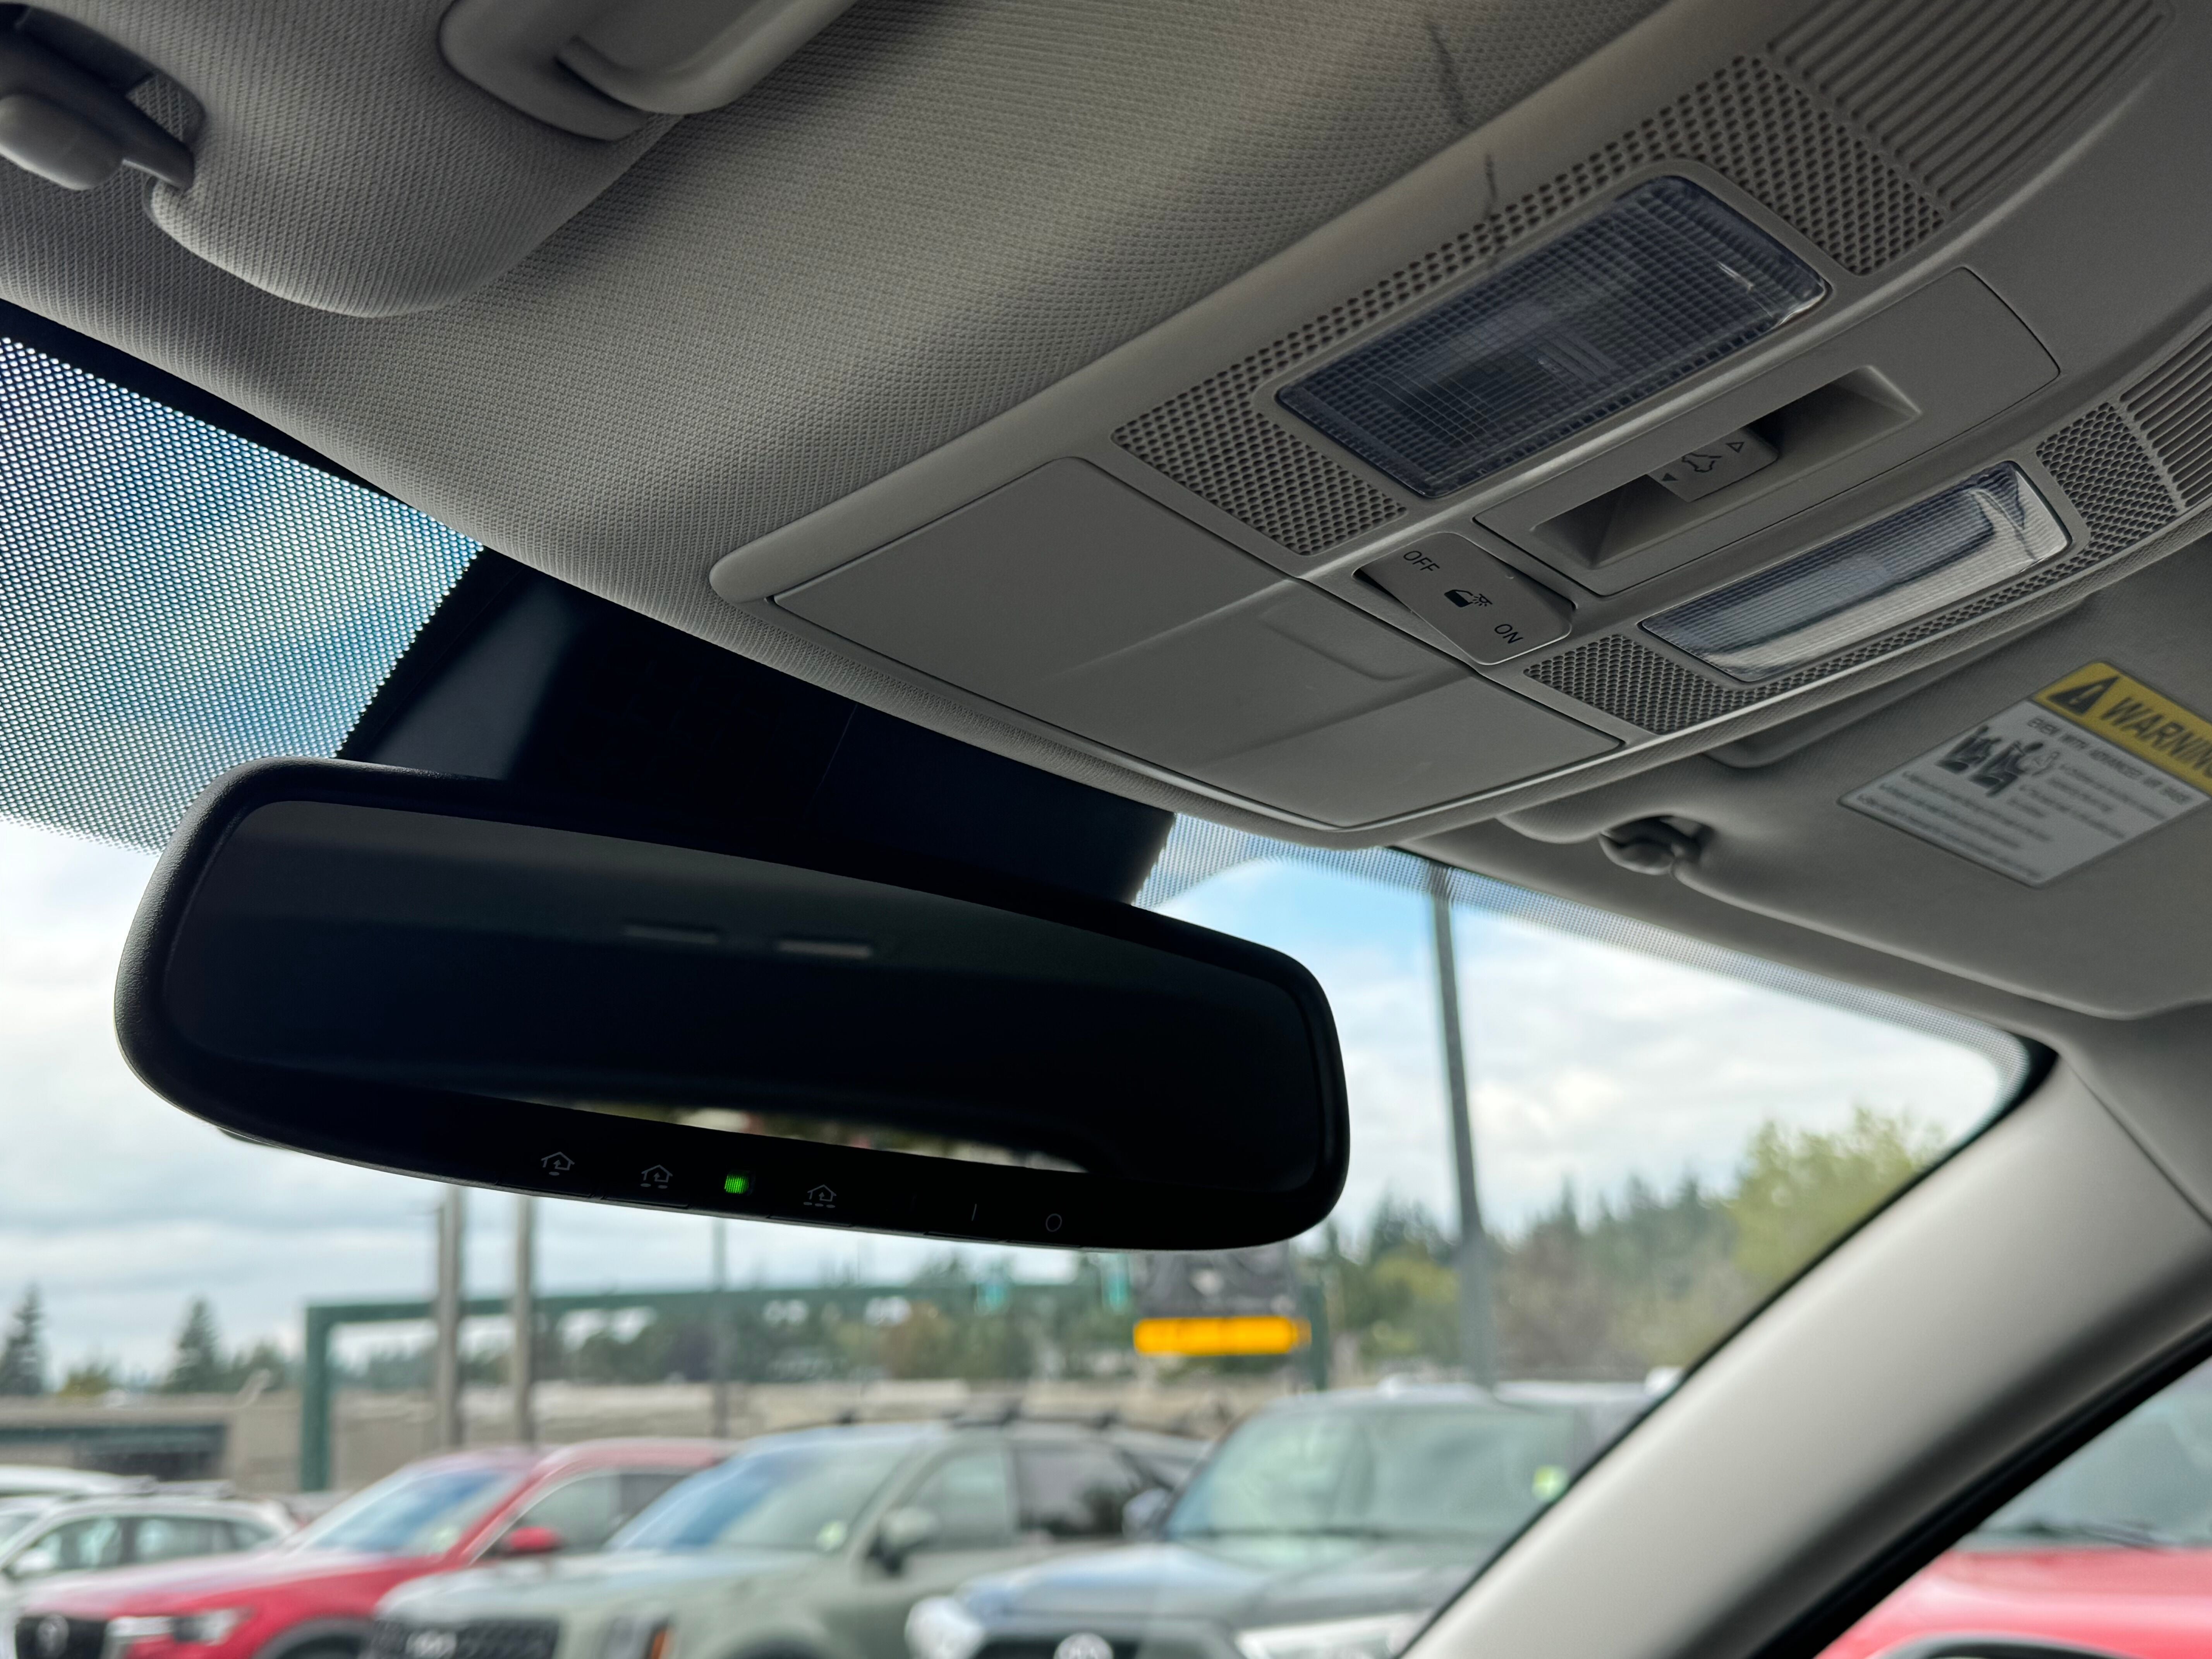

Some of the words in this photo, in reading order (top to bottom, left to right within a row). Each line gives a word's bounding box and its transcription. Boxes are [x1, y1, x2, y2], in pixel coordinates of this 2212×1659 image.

[1403, 550, 1440, 571] OFF
[1494, 623, 1523, 644] ON
[2100, 696, 2212, 778] WARNIN
